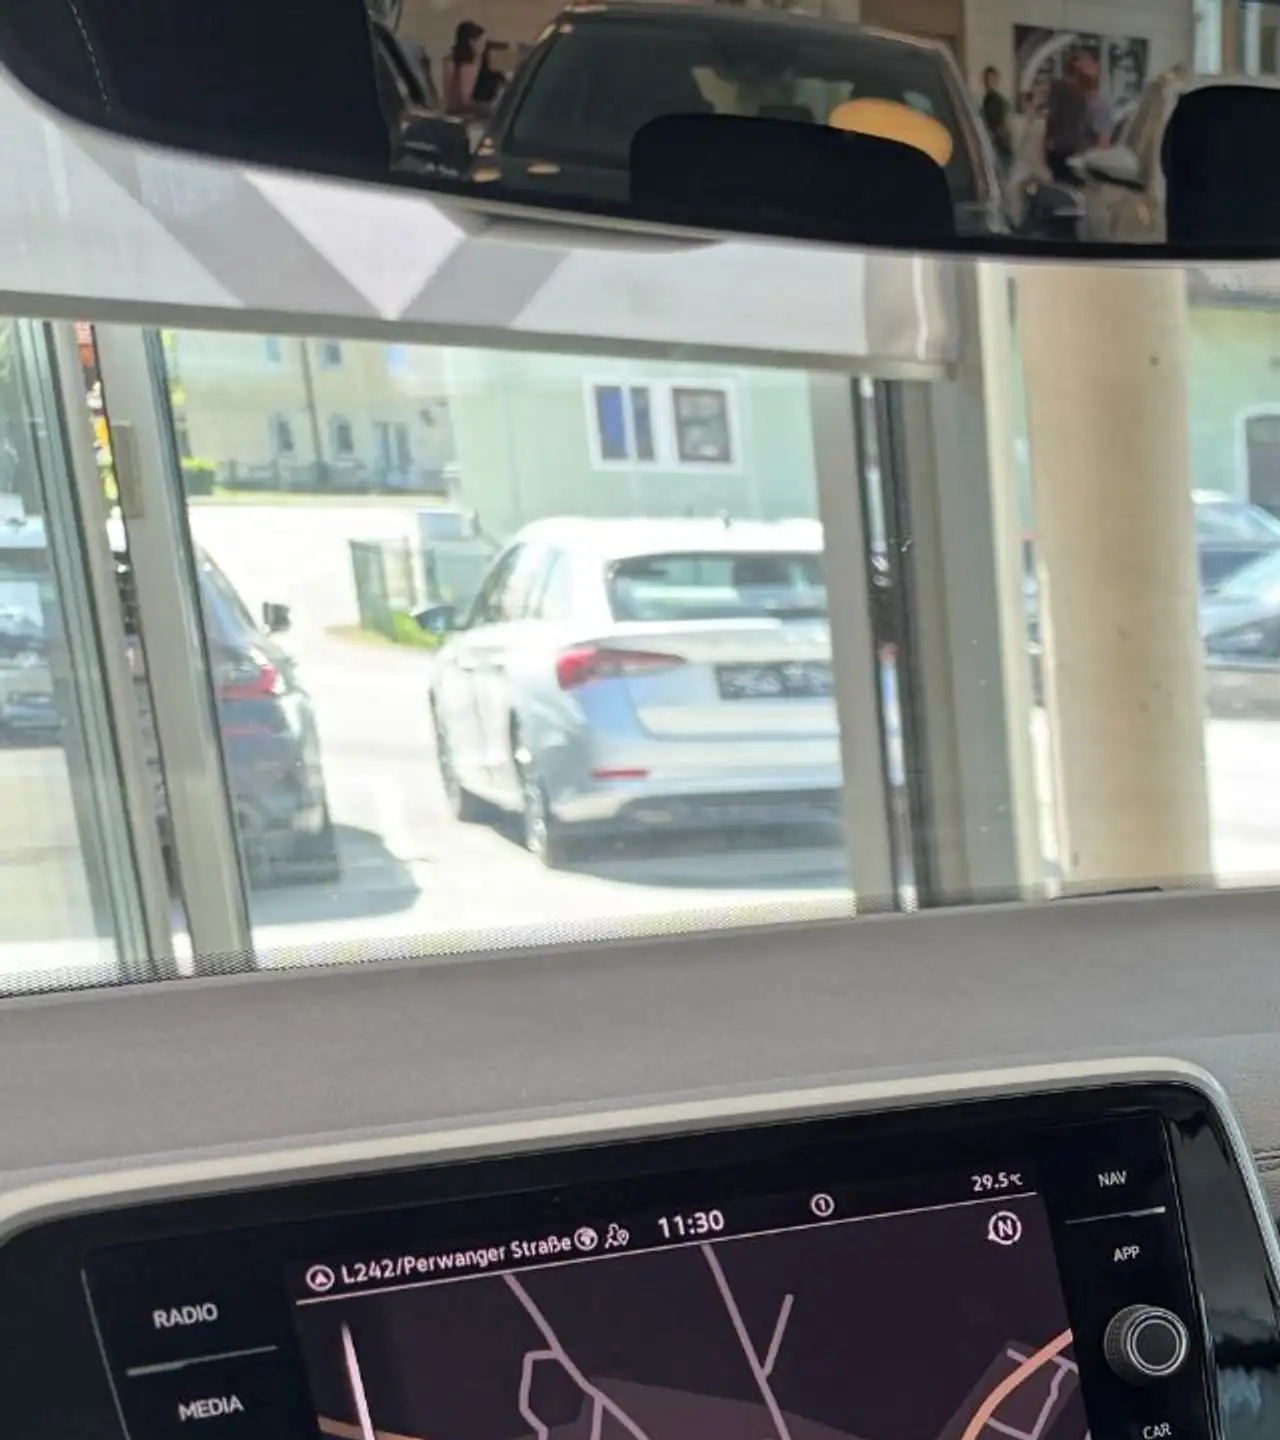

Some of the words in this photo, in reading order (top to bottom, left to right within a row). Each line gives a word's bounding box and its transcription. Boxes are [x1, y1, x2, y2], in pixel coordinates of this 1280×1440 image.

[1098, 1170, 1128, 1187] NAV
[657, 1209, 725, 1240] 11:30
[998, 1219, 1013, 1237] N
[340, 1245, 506, 1284] L242/Perwanger
[511, 1235, 572, 1259] Straße
[1113, 1244, 1141, 1262] APP
[152, 1302, 218, 1329] RADIO
[178, 1394, 244, 1422] MEDIA
[1142, 1421, 1173, 1440] CAR
